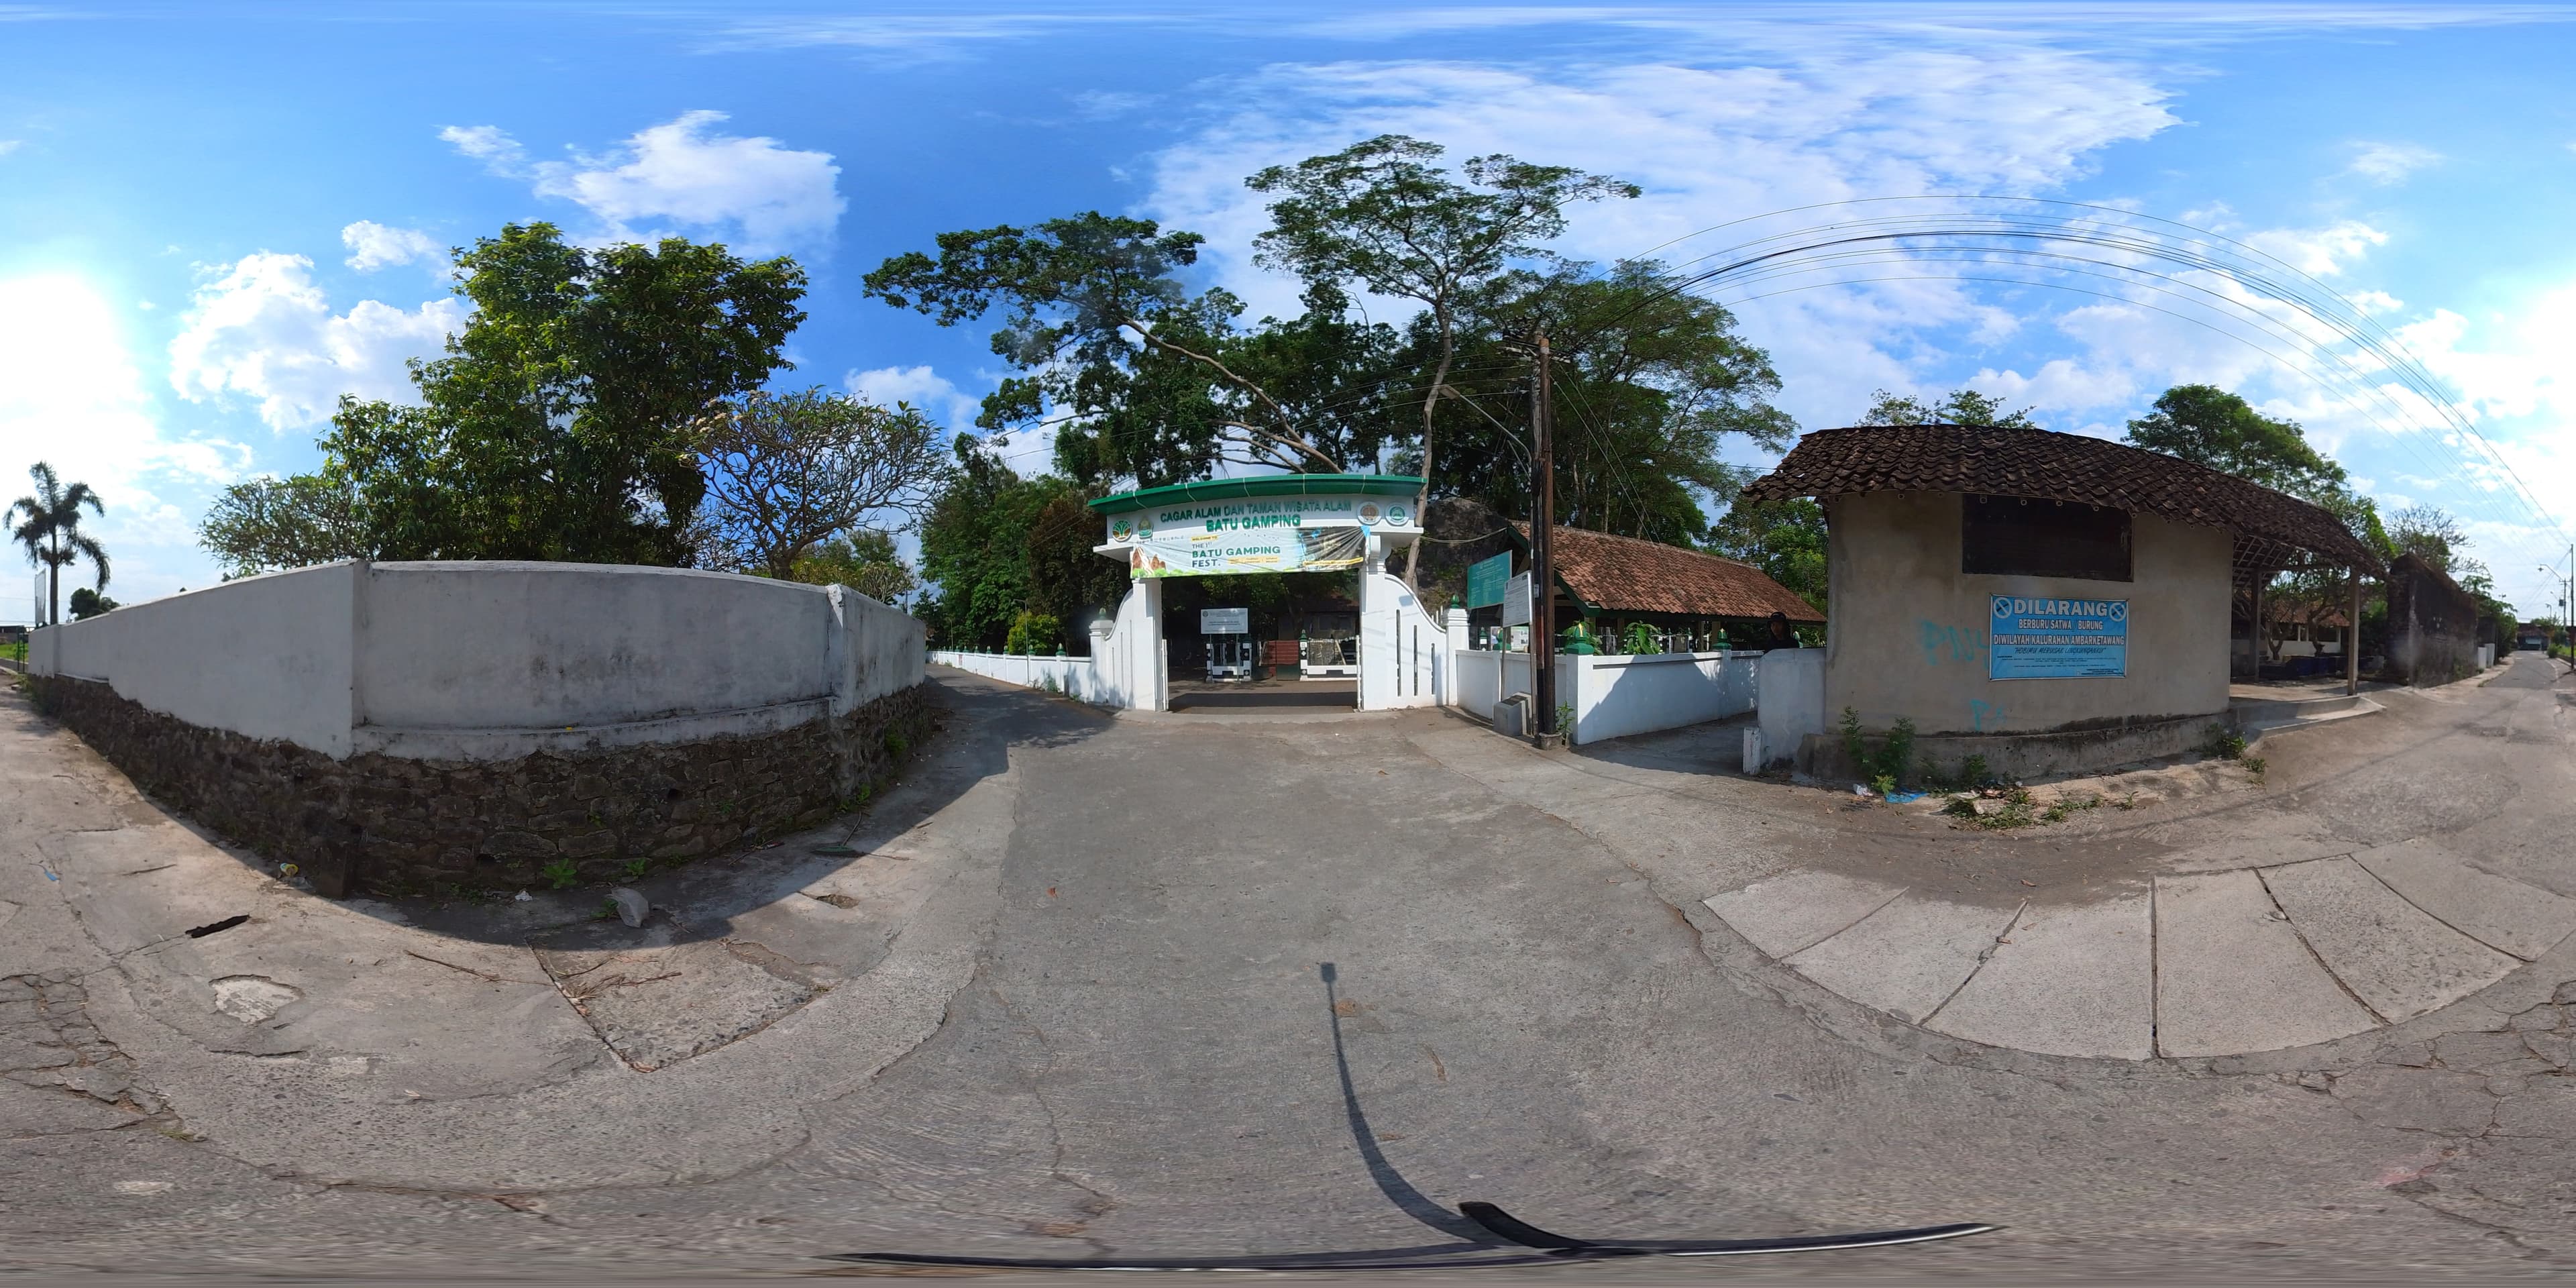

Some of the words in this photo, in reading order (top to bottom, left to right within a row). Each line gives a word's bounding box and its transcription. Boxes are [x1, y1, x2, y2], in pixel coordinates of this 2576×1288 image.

[1160, 510, 1193, 523] CAGAR
[1195, 506, 1221, 519] ALAM
[1224, 504, 1244, 516] DAN
[1246, 501, 1281, 515] TAMAN
[1284, 500, 1322, 513] WISATA
[1323, 500, 1352, 511] ALAM
[1206, 517, 1238, 532] BATU
[1242, 514, 1301, 529] GAMPING
[1192, 549, 1222, 558] BATU
[1226, 546, 1281, 555] GAMPING
[1192, 559, 1221, 568] FEST.
[2014, 599, 2107, 616] DILARANG
[2019, 619, 2049, 629] BERBURU
[2050, 619, 2072, 629] SATWA
[2078, 621, 2103, 629] BURUNG
[1994, 634, 2030, 645] DIWILAYAH
[2031, 635, 2070, 645] KALURAHAN
[2071, 635, 2125, 645] AMBARKETAWANG
